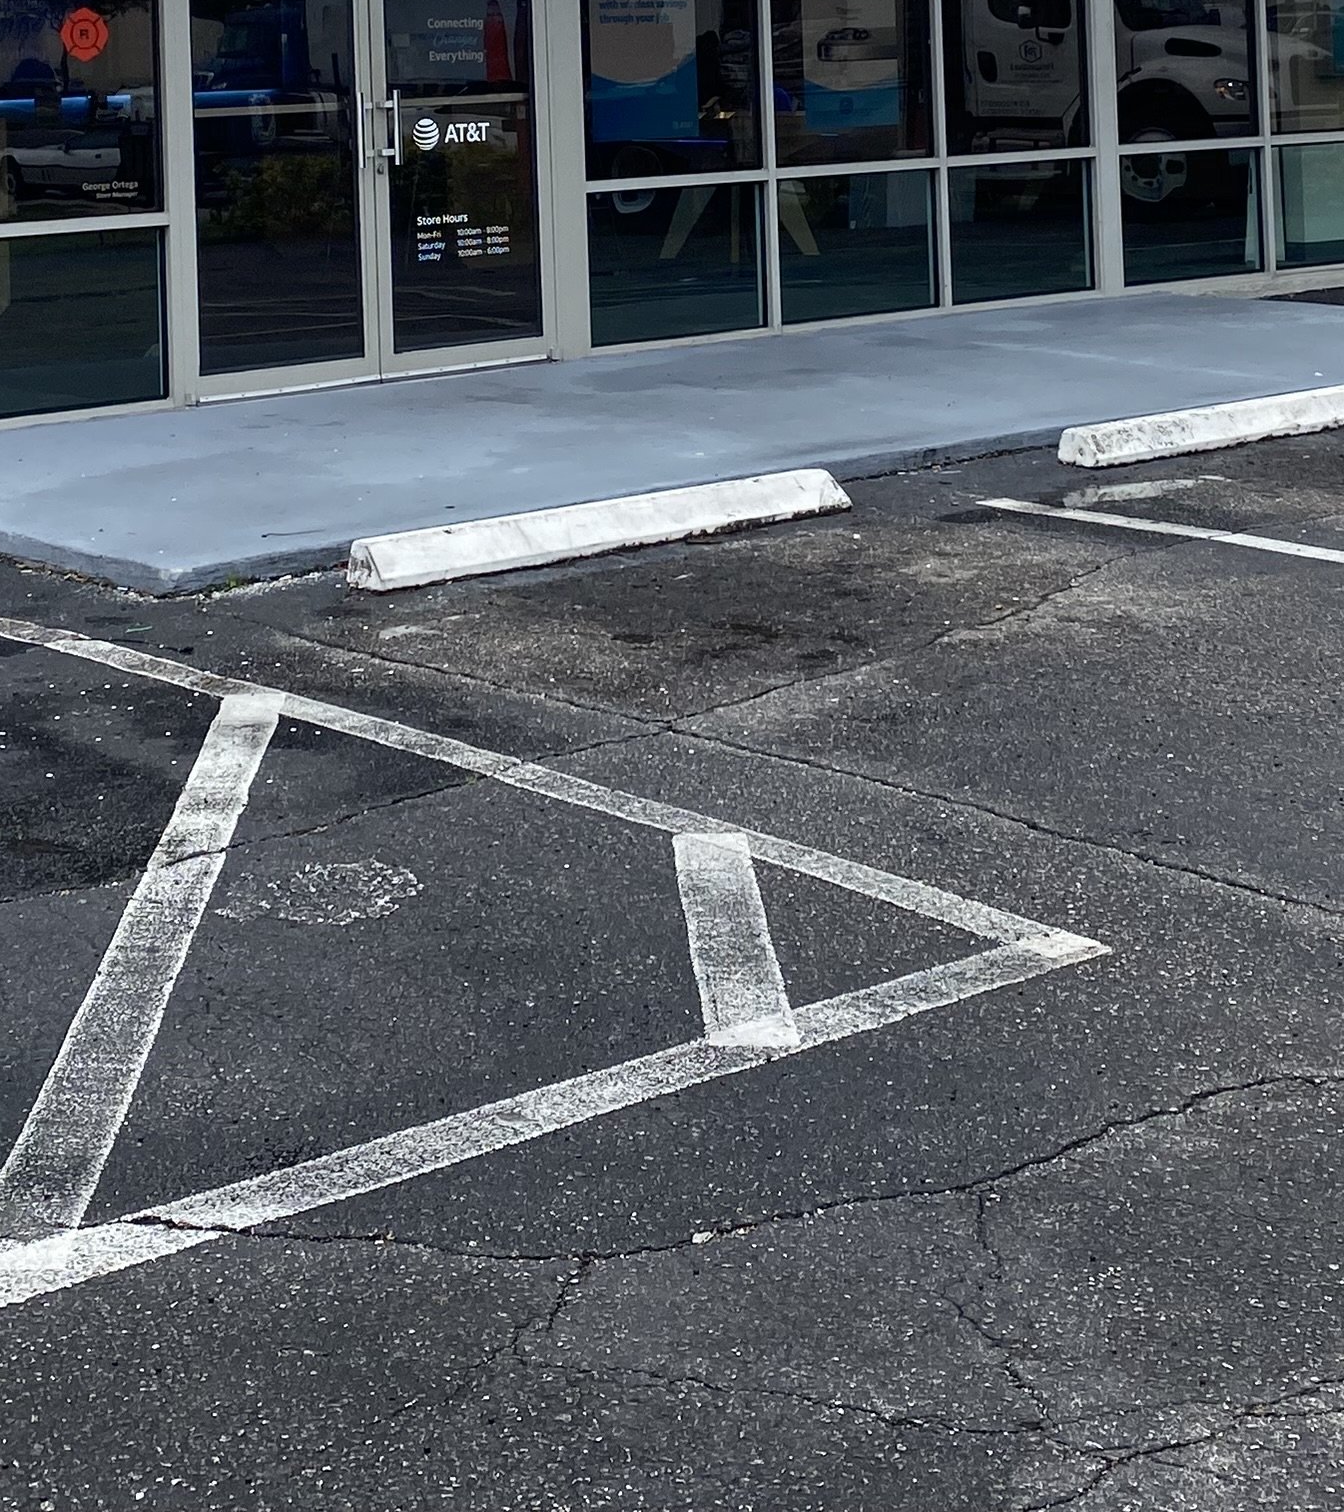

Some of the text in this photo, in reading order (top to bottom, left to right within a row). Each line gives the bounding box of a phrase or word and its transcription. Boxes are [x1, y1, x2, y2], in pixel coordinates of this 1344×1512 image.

[427, 17, 484, 30] Connecting
[429, 49, 484, 64] Everything
[444, 122, 490, 143] AT&T
[81, 180, 139, 191] George Ortega
[417, 214, 468, 226] Store Hours
[418, 242, 446, 251] Saturday
[418, 252, 441, 261] Sunday
